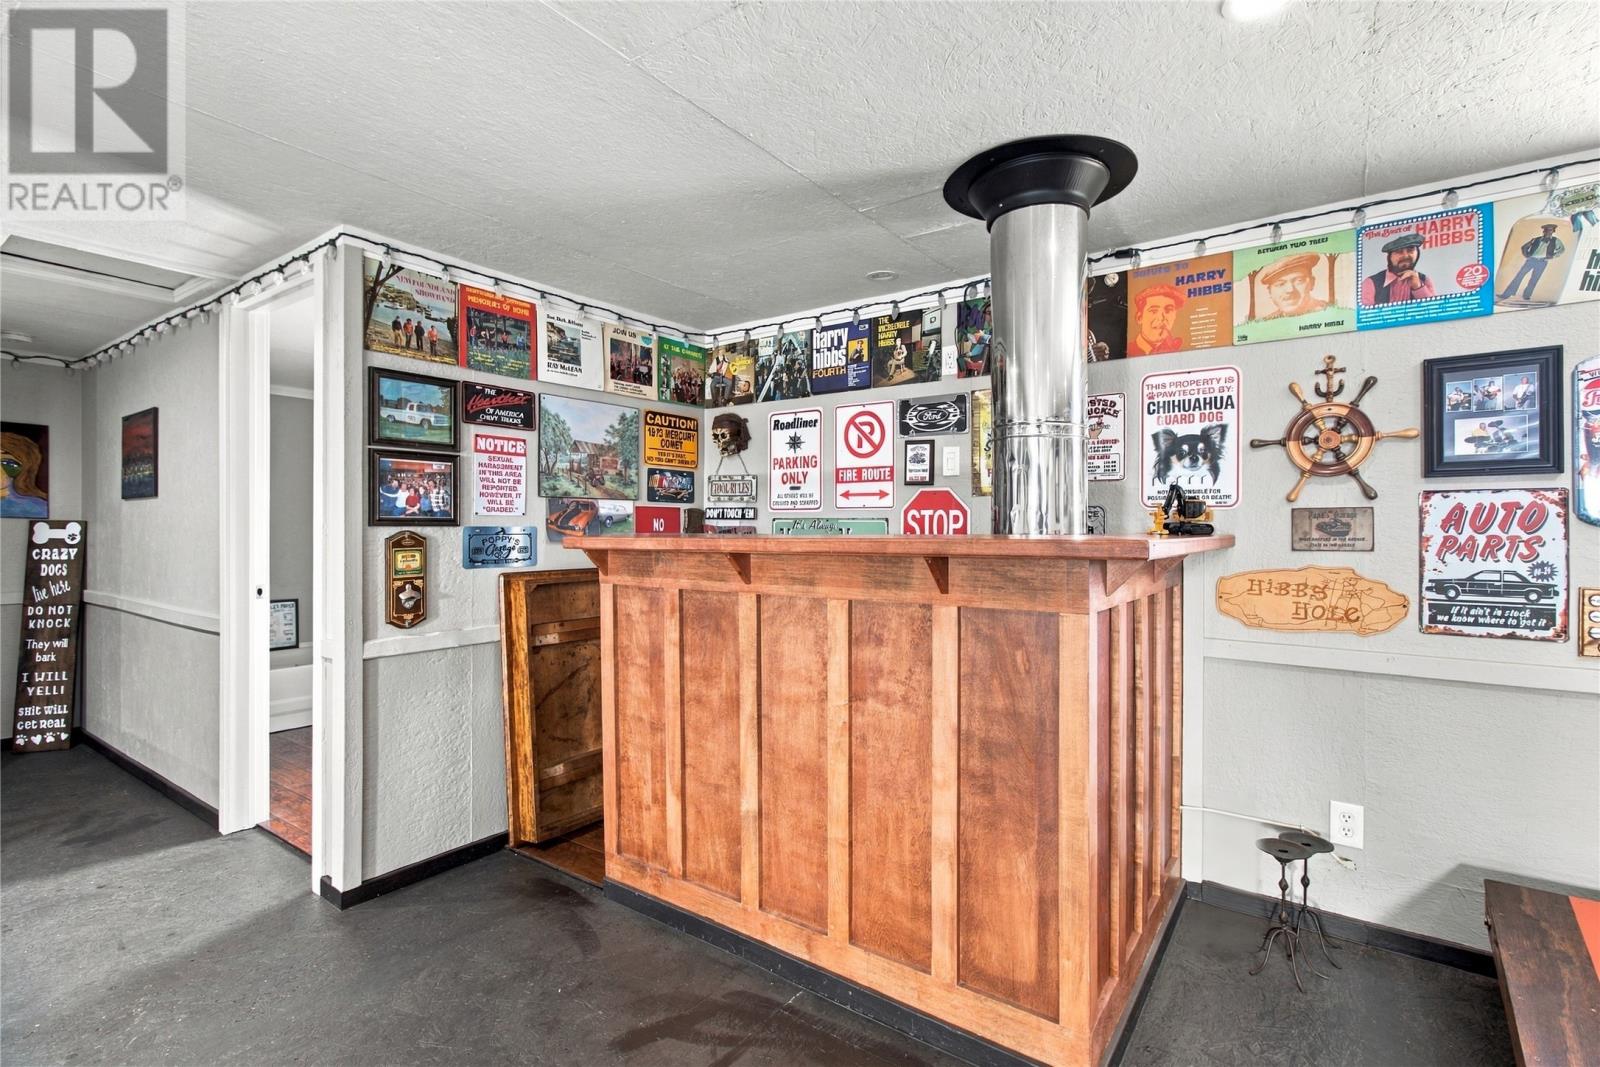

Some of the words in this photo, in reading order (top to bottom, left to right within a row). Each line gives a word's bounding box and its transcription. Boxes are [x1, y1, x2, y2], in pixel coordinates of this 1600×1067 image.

[1416, 214, 1474, 235] HARRY
[1382, 228, 1402, 238] Best
[1423, 228, 1476, 250] HIBBS
[1258, 244, 1288, 254] BETWEEN
[1310, 237, 1328, 245] TREES
[1176, 268, 1226, 286] HARRY
[1464, 266, 1482, 276] 20
[1188, 282, 1232, 298] HIBBS
[878, 316, 890, 324] THE
[878, 320, 910, 332] INCREDIBLE
[1299, 323, 1322, 331] HARRY
[812, 328, 848, 348] harry
[812, 346, 847, 370] hibbs
[812, 366, 846, 378] FOURTH
[1169, 377, 1222, 389] PROPERTY
[1156, 387, 1215, 399] PAWTECTED
[1088, 399, 1117, 408] STED
[1146, 395, 1235, 415] CHIHUAHUA
[495, 410, 524, 418] AMERICA
[922, 412, 942, 420] Ford
[1088, 407, 1119, 418] UCKLE
[1156, 413, 1195, 426] GUARD
[1199, 411, 1224, 423] DOG
[646, 414, 697, 430] CAUTION!
[773, 417, 818, 430] Roadliner
[665, 430, 696, 442] MERCURY
[476, 436, 526, 454] NOTICE
[660, 438, 683, 449] COMET
[478, 462, 523, 471] HARASSMENT
[773, 455, 818, 470] PARKING
[782, 472, 808, 485] ONLY
[838, 470, 857, 482] FIRE
[862, 468, 891, 481] ROUTE
[724, 508, 742, 518] TOUCH
[1440, 500, 1550, 534] AUTO
[653, 518, 665, 532] NO
[907, 510, 964, 535] STOP
[482, 536, 520, 546] POPPY'S
[485, 544, 516, 558] Garage
[1435, 534, 1546, 564] PARTS
[40, 564, 68, 576] DOGS
[32, 586, 49, 602] live
[49, 580, 71, 596] here
[28, 606, 44, 616] DO
[48, 606, 72, 615] NOT
[1450, 606, 1460, 614] If
[1470, 607, 1490, 616] ain't
[1493, 608, 1502, 616] in
[1505, 609, 1531, 618] stock
[28, 618, 72, 629] KNOCK
[1451, 614, 1475, 623] know
[1478, 616, 1506, 625] where
[1520, 618, 1536, 628] get
[26, 639, 50, 652] They
[52, 638, 69, 648] will
[35, 652, 56, 662] bark
[22, 672, 29, 682] I
[35, 671, 68, 682] WILL
